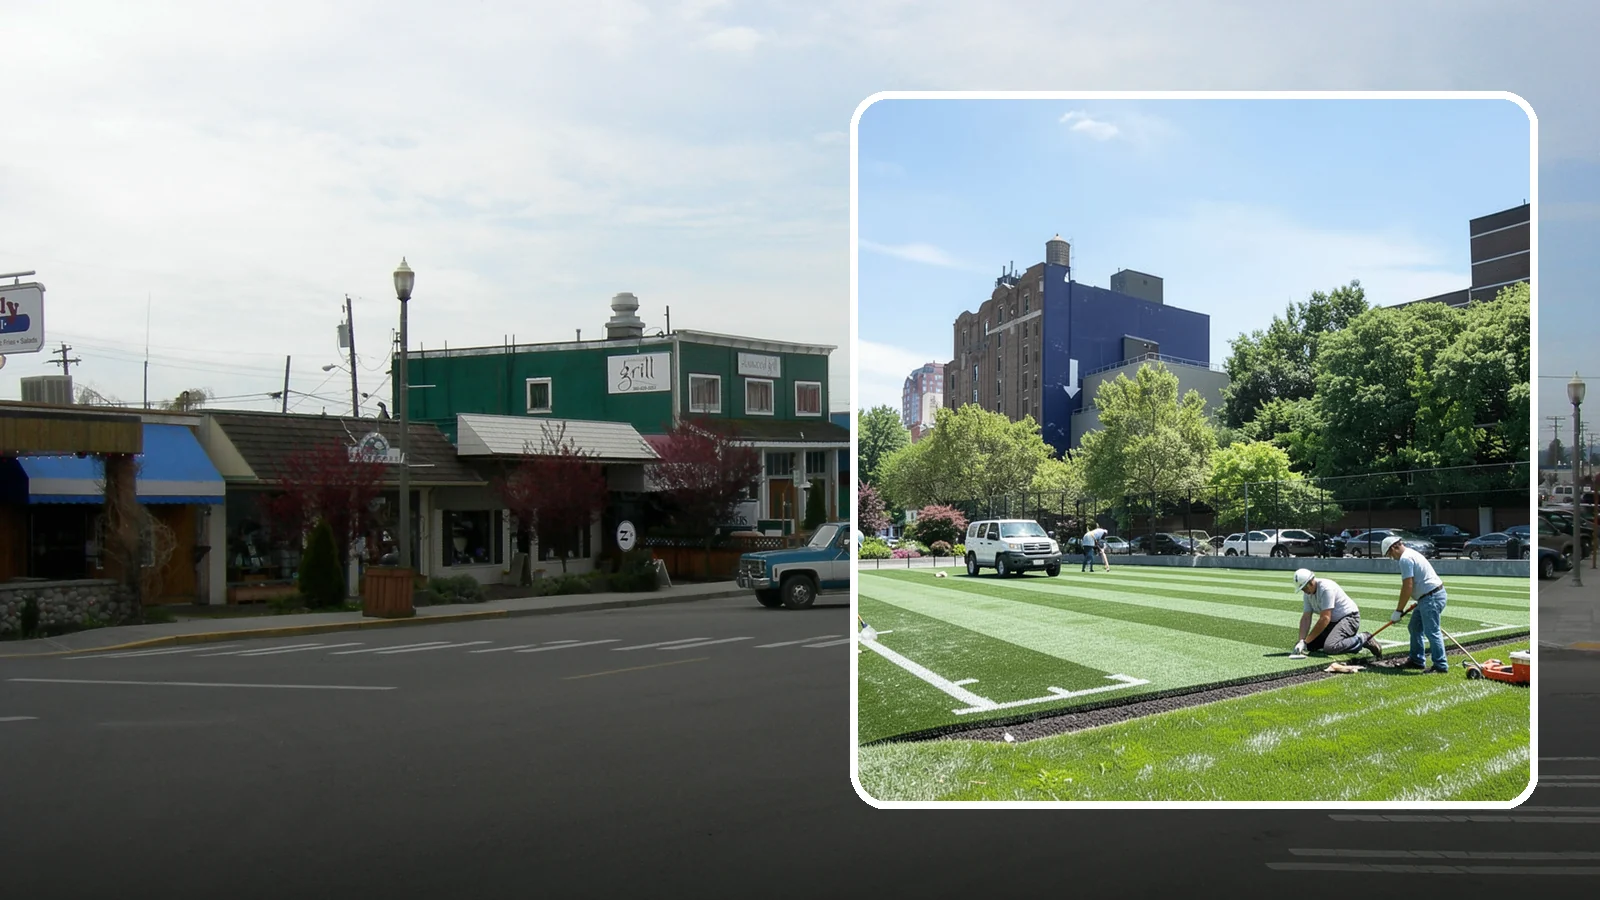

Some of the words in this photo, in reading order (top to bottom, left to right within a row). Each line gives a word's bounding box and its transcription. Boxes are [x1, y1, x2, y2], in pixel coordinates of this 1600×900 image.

[0, 296, 19, 325] ly
[20, 336, 38, 344] Salads
[617, 356, 655, 391] grill
